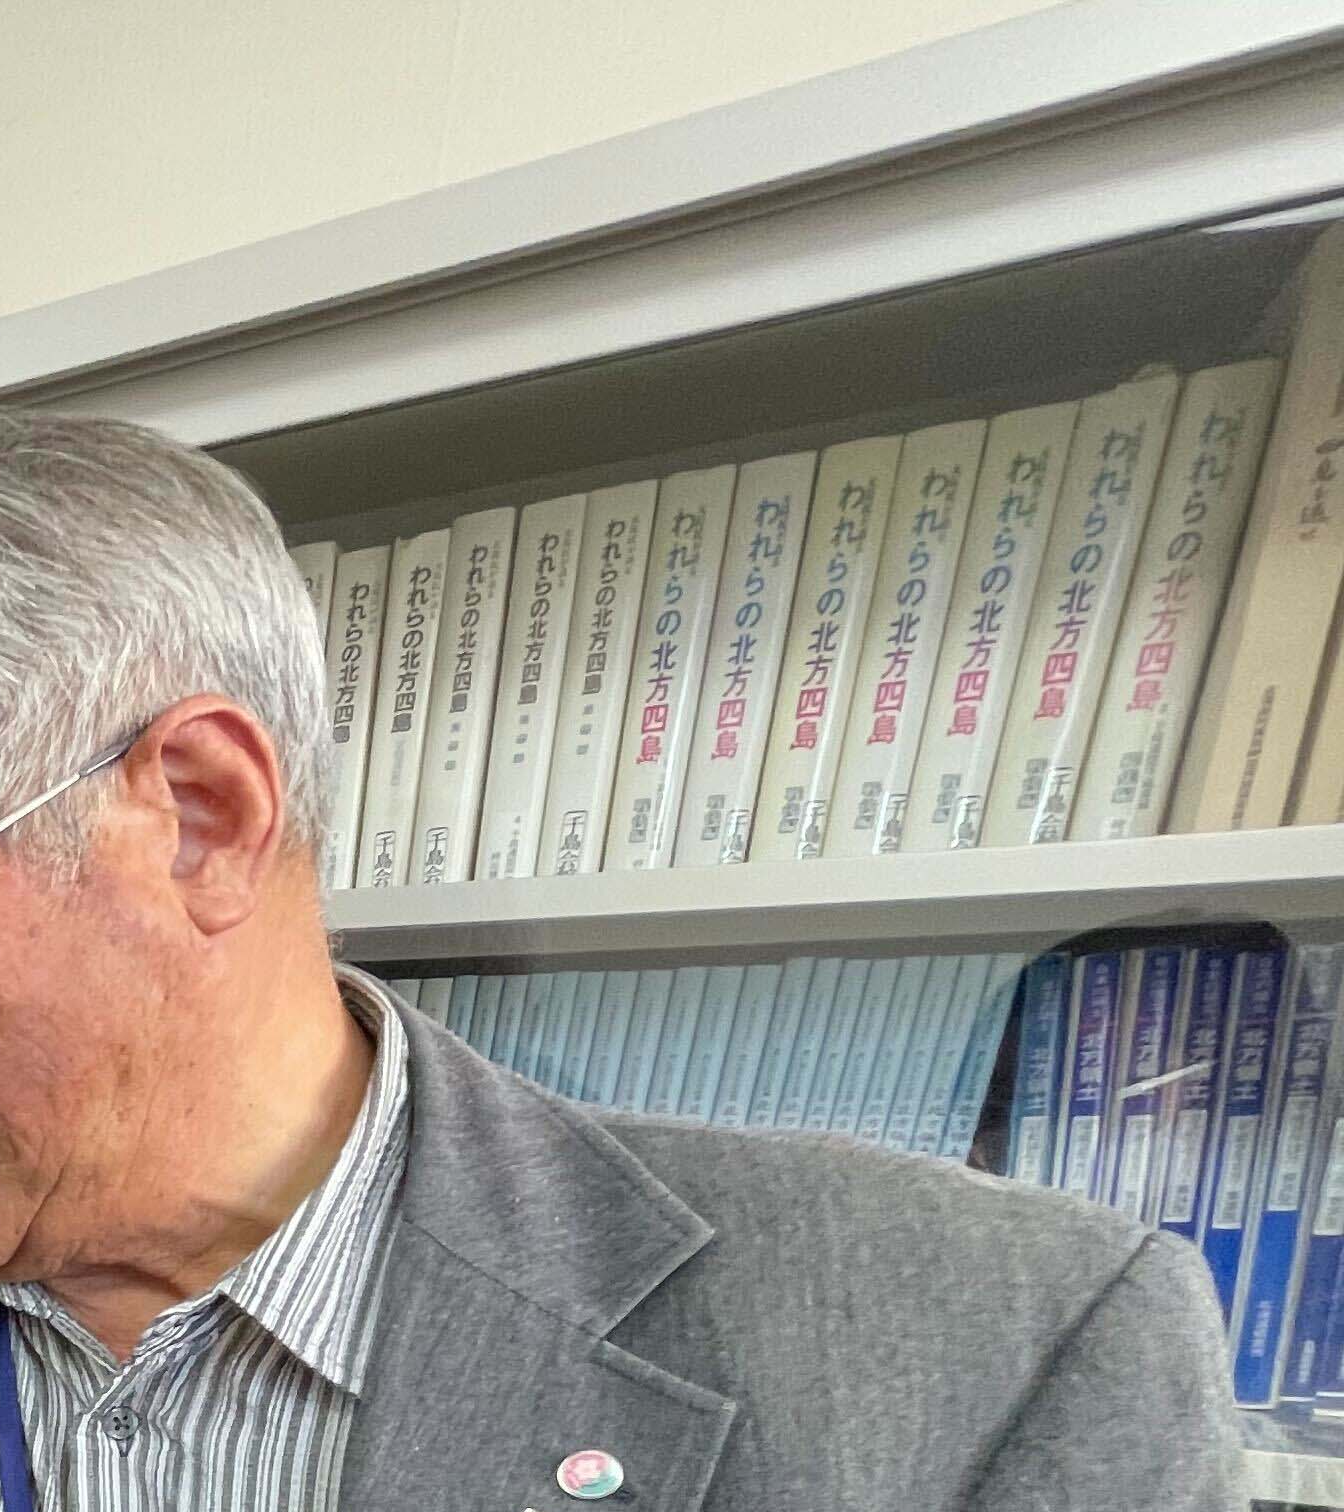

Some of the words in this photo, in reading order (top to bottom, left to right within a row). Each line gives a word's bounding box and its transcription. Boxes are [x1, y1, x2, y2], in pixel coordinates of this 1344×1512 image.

[711, 499, 782, 760] われらの北方四島
[790, 481, 866, 751] われらの北方四島
[867, 467, 949, 745] われらの北方四島
[947, 454, 1035, 737] われらの北方四島
